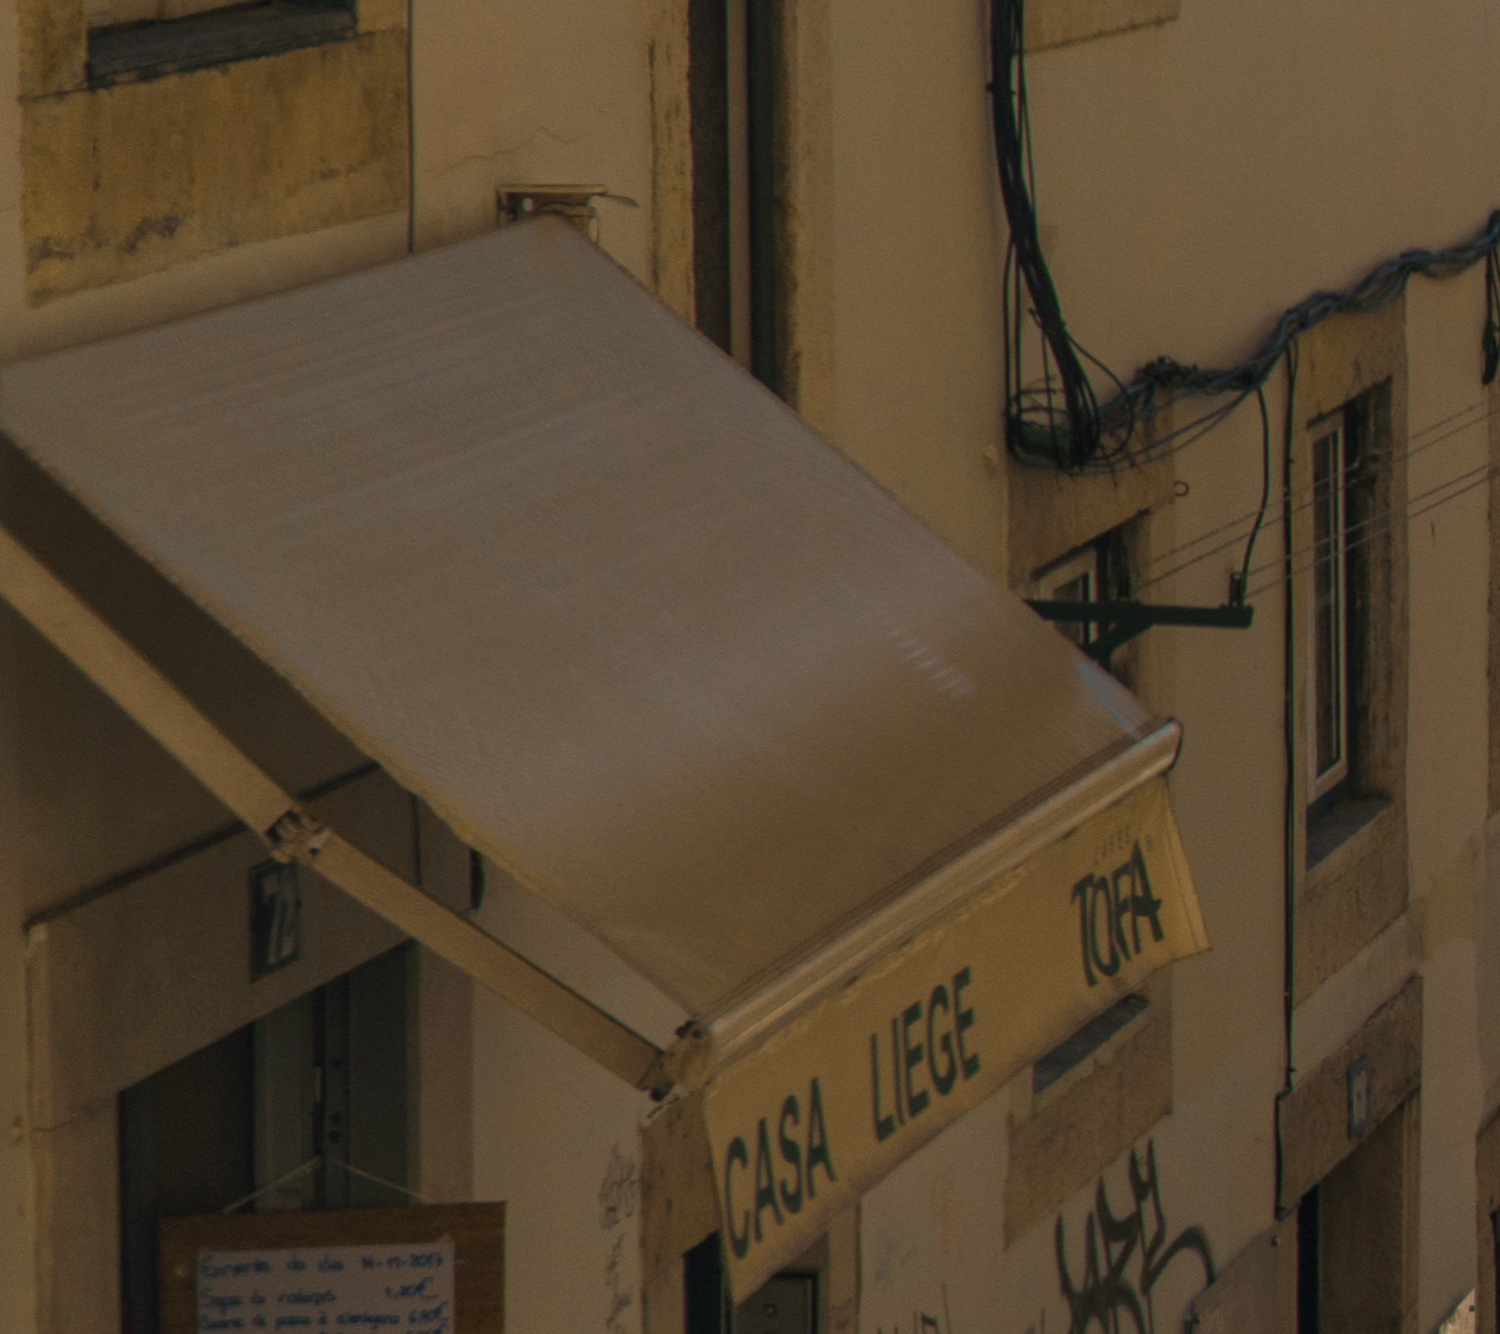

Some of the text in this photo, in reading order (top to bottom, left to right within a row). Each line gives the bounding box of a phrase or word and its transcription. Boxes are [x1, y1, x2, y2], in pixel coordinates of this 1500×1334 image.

[1071, 838, 1164, 987] TOFA
[725, 967, 981, 1259] CASA LIEGE
